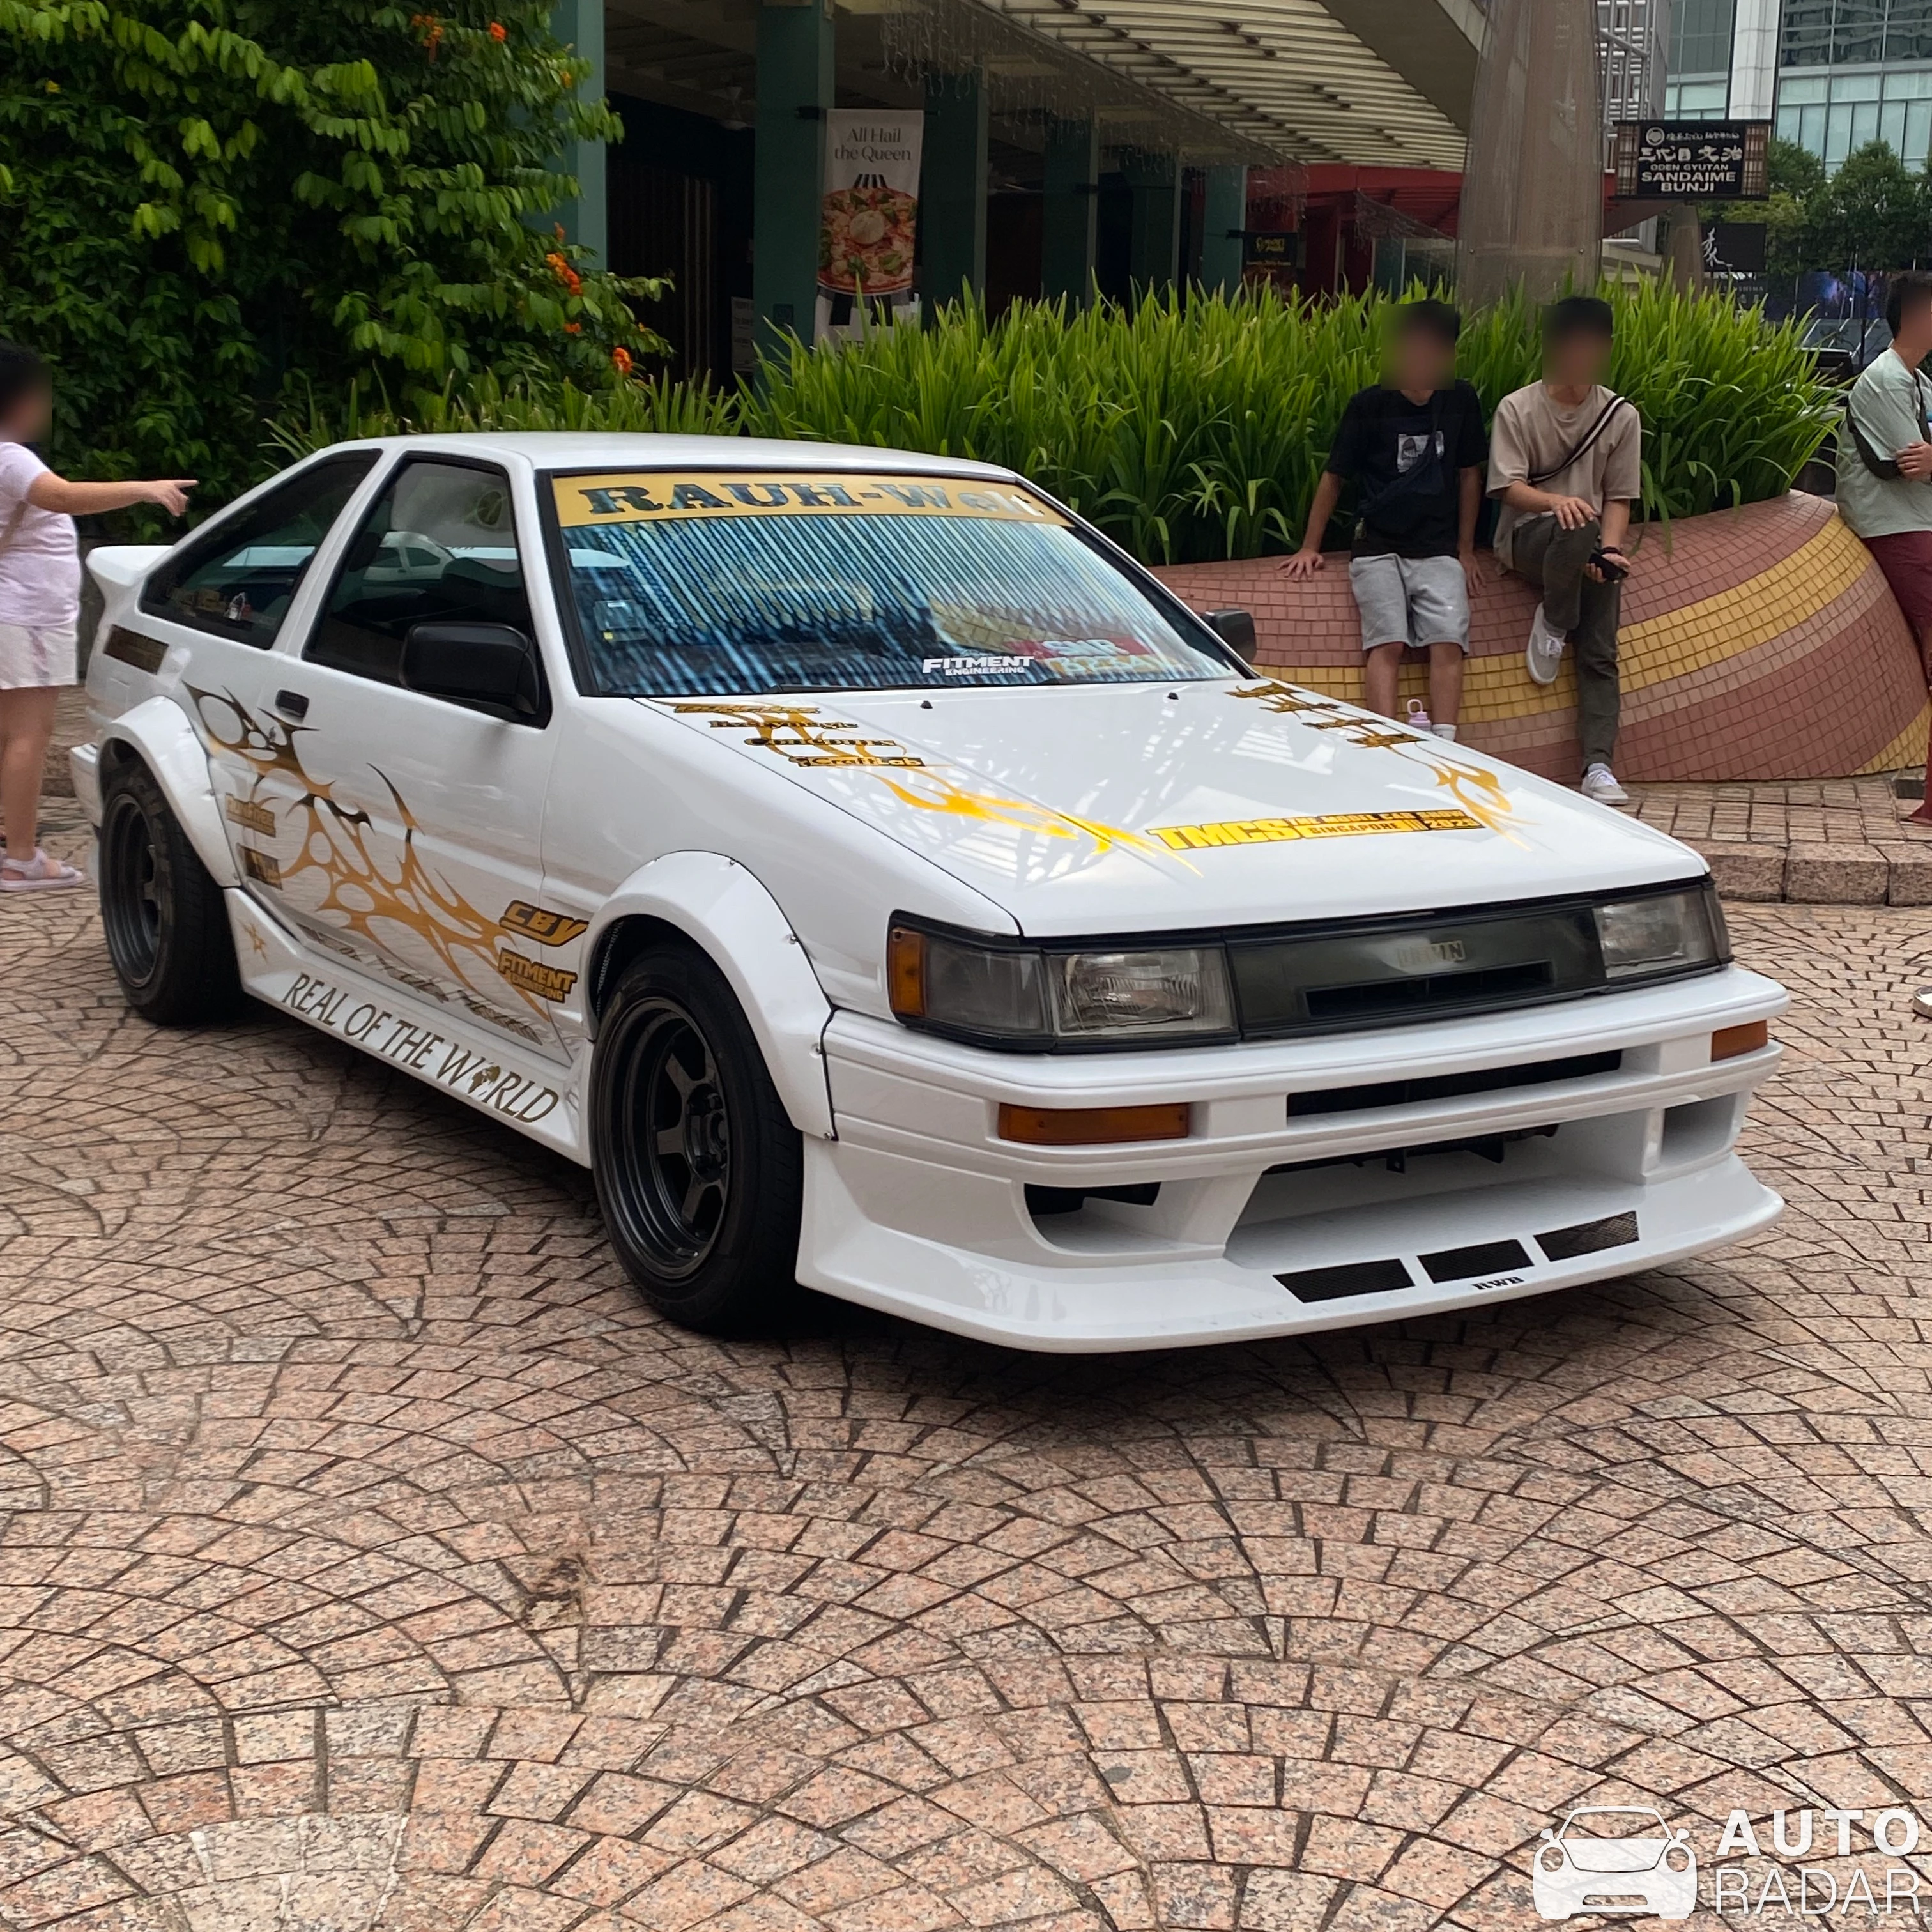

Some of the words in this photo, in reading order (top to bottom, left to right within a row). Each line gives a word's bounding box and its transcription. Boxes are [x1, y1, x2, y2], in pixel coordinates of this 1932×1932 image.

[847, 127, 867, 142] All
[871, 127, 901, 143] Hail
[834, 144, 858, 160] the
[861, 145, 911, 163] Queen
[1641, 171, 1736, 182] SANDAIME
[1661, 182, 1715, 192] BUNJI
[923, 656, 1034, 673] FITMENT
[945, 667, 1025, 676] ENGINEERING
[1285, 817, 1321, 826] THE
[1321, 813, 1379, 824] MODEL
[1380, 812, 1416, 820] CAR
[1147, 819, 1301, 850] TMCS
[1309, 822, 1400, 834] SINGAPORE
[499, 951, 577, 992] FITMENT
[512, 974, 564, 1000] ENGINEERING
[282, 972, 348, 1027] REAL
[344, 1004, 391, 1041] OF
[379, 1020, 445, 1070] THE
[1471, 1276, 1525, 1290] RWB
